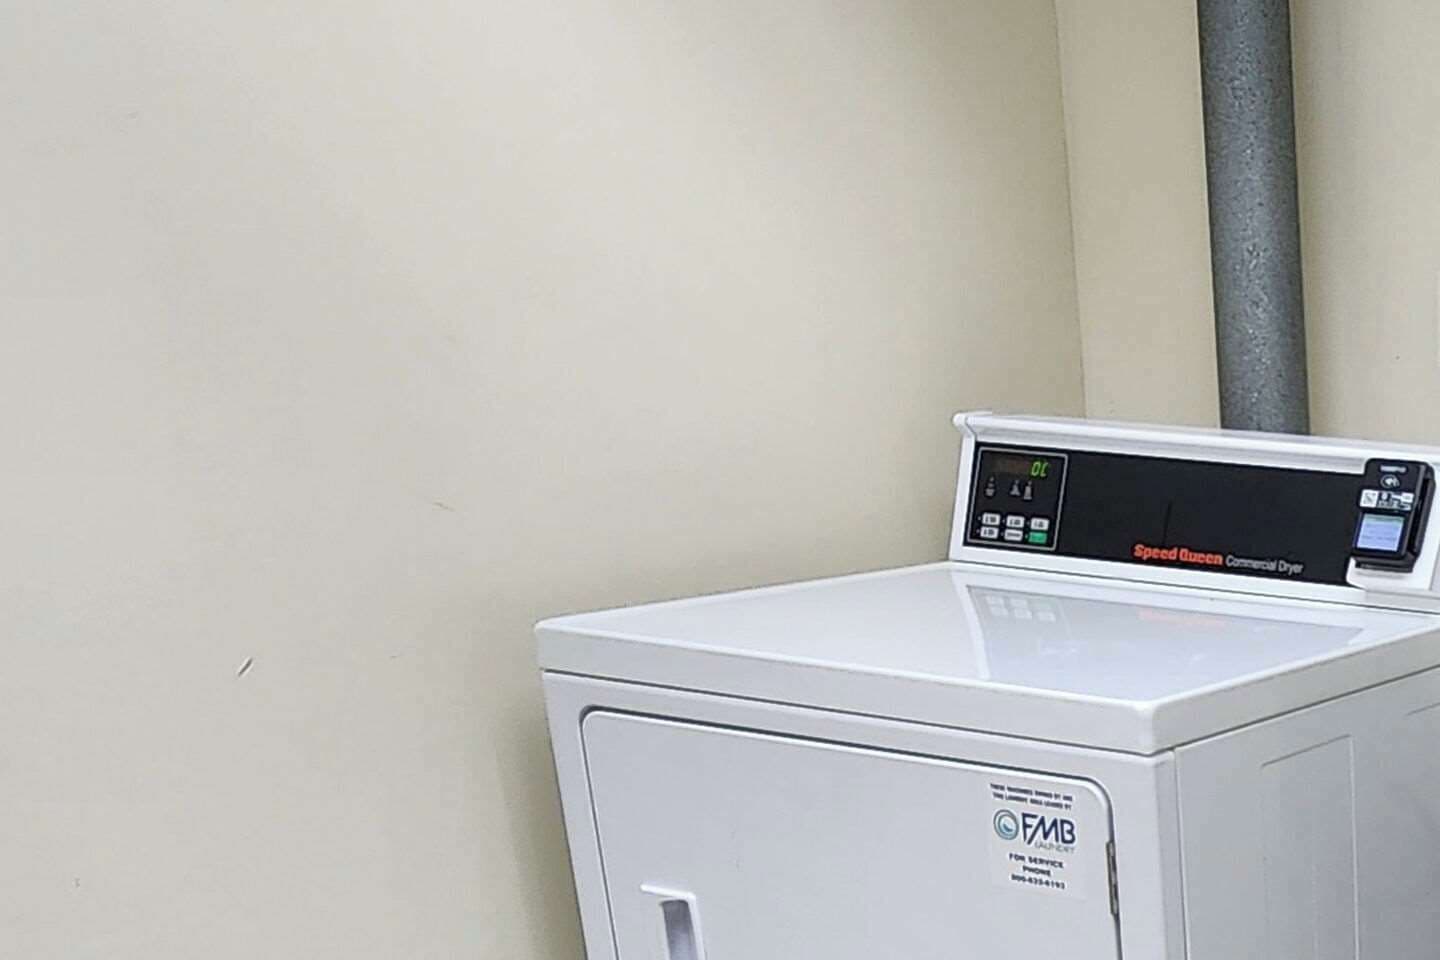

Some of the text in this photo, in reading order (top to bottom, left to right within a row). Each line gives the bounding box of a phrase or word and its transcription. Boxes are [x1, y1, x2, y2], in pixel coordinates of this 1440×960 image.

[1134, 543, 1304, 576] Speed Queen Commercial Dryer
[1021, 811, 1076, 845] FMB
